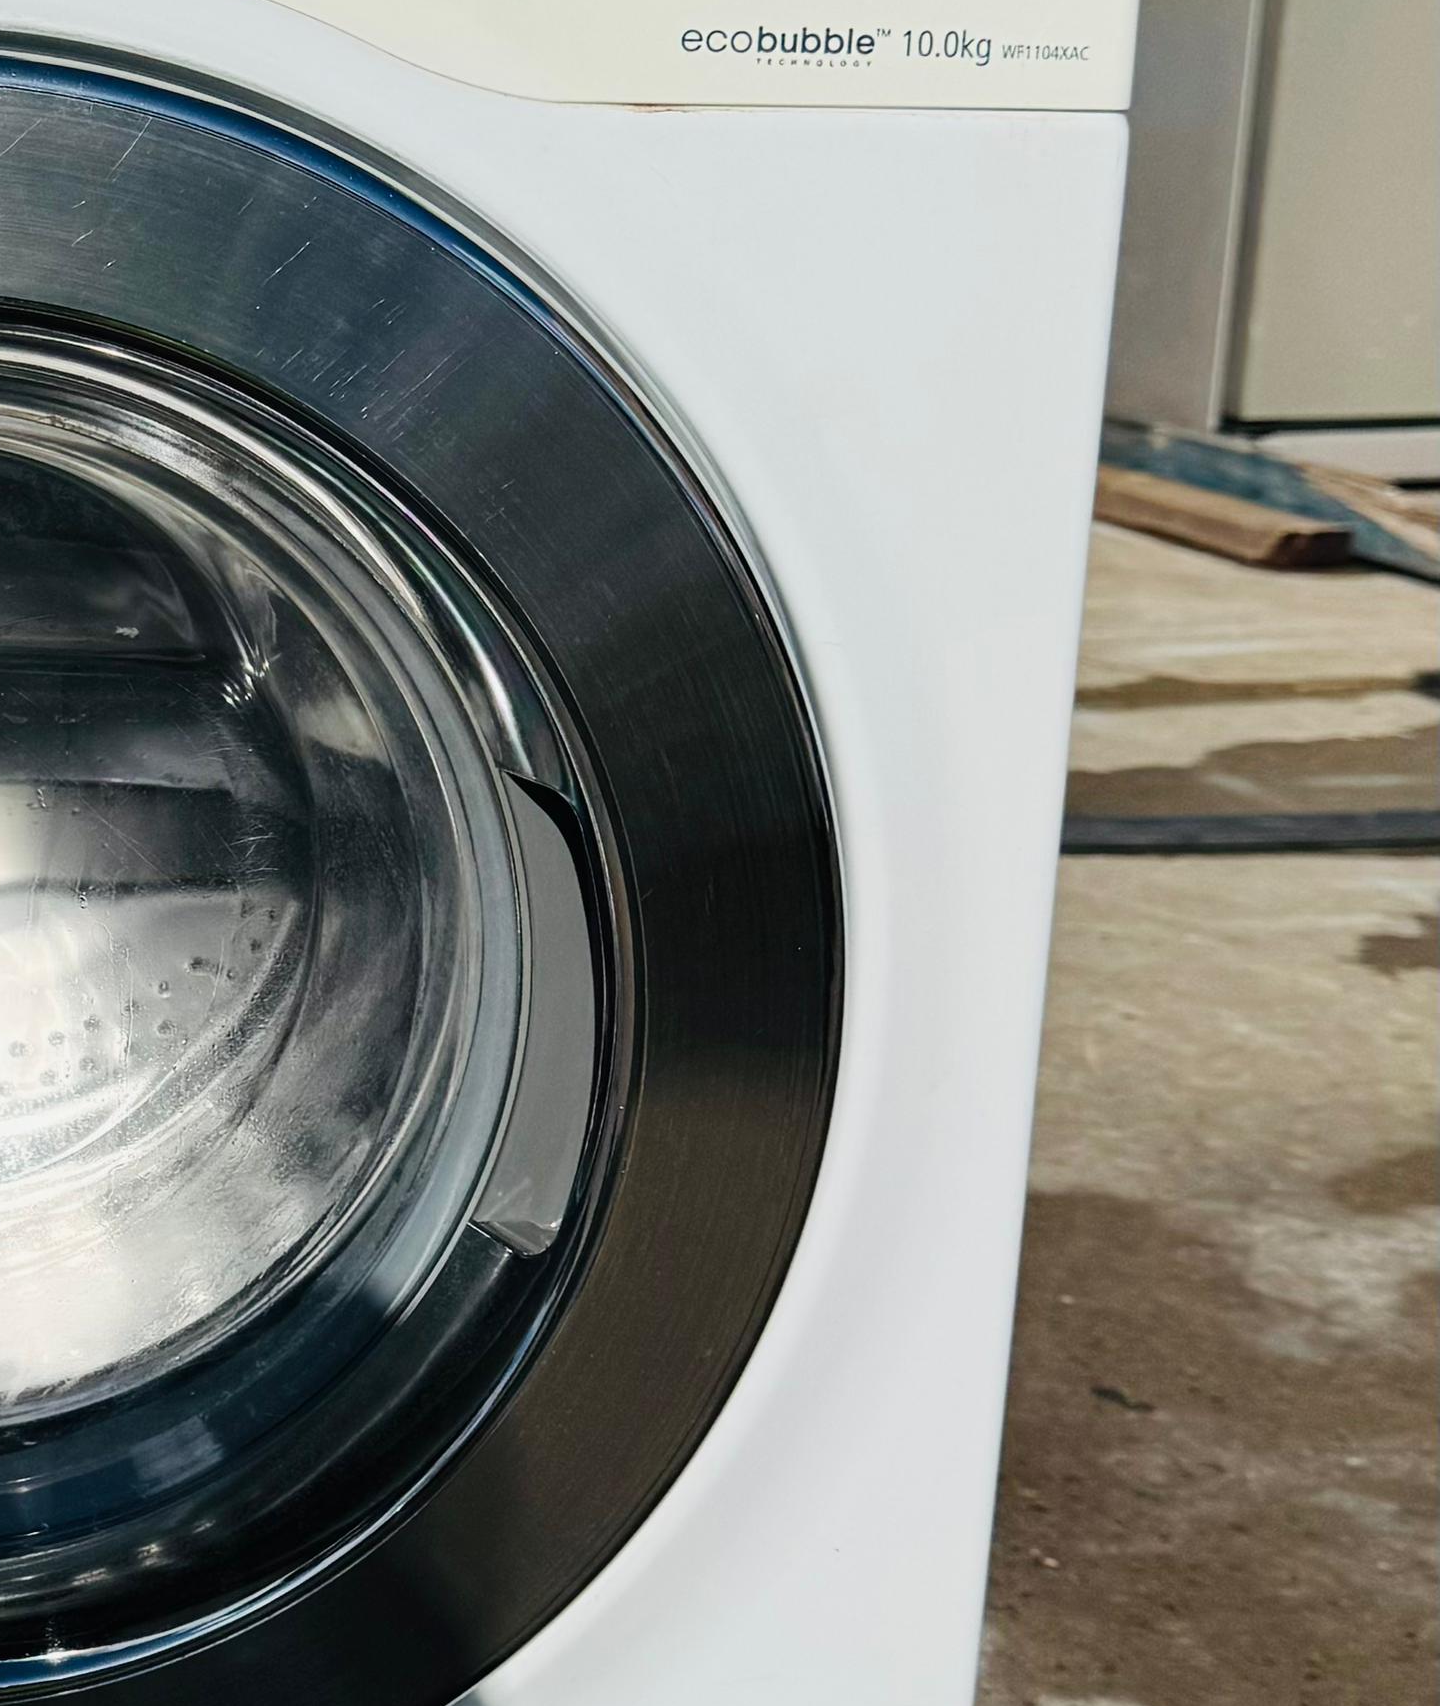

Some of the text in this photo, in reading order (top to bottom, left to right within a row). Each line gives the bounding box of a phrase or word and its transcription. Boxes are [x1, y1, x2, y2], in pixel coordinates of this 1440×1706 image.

[903, 29, 992, 67] 10.0kg
[1002, 44, 1091, 61] WF1104XAC
[756, 57, 873, 68] TECHNOLOGY
